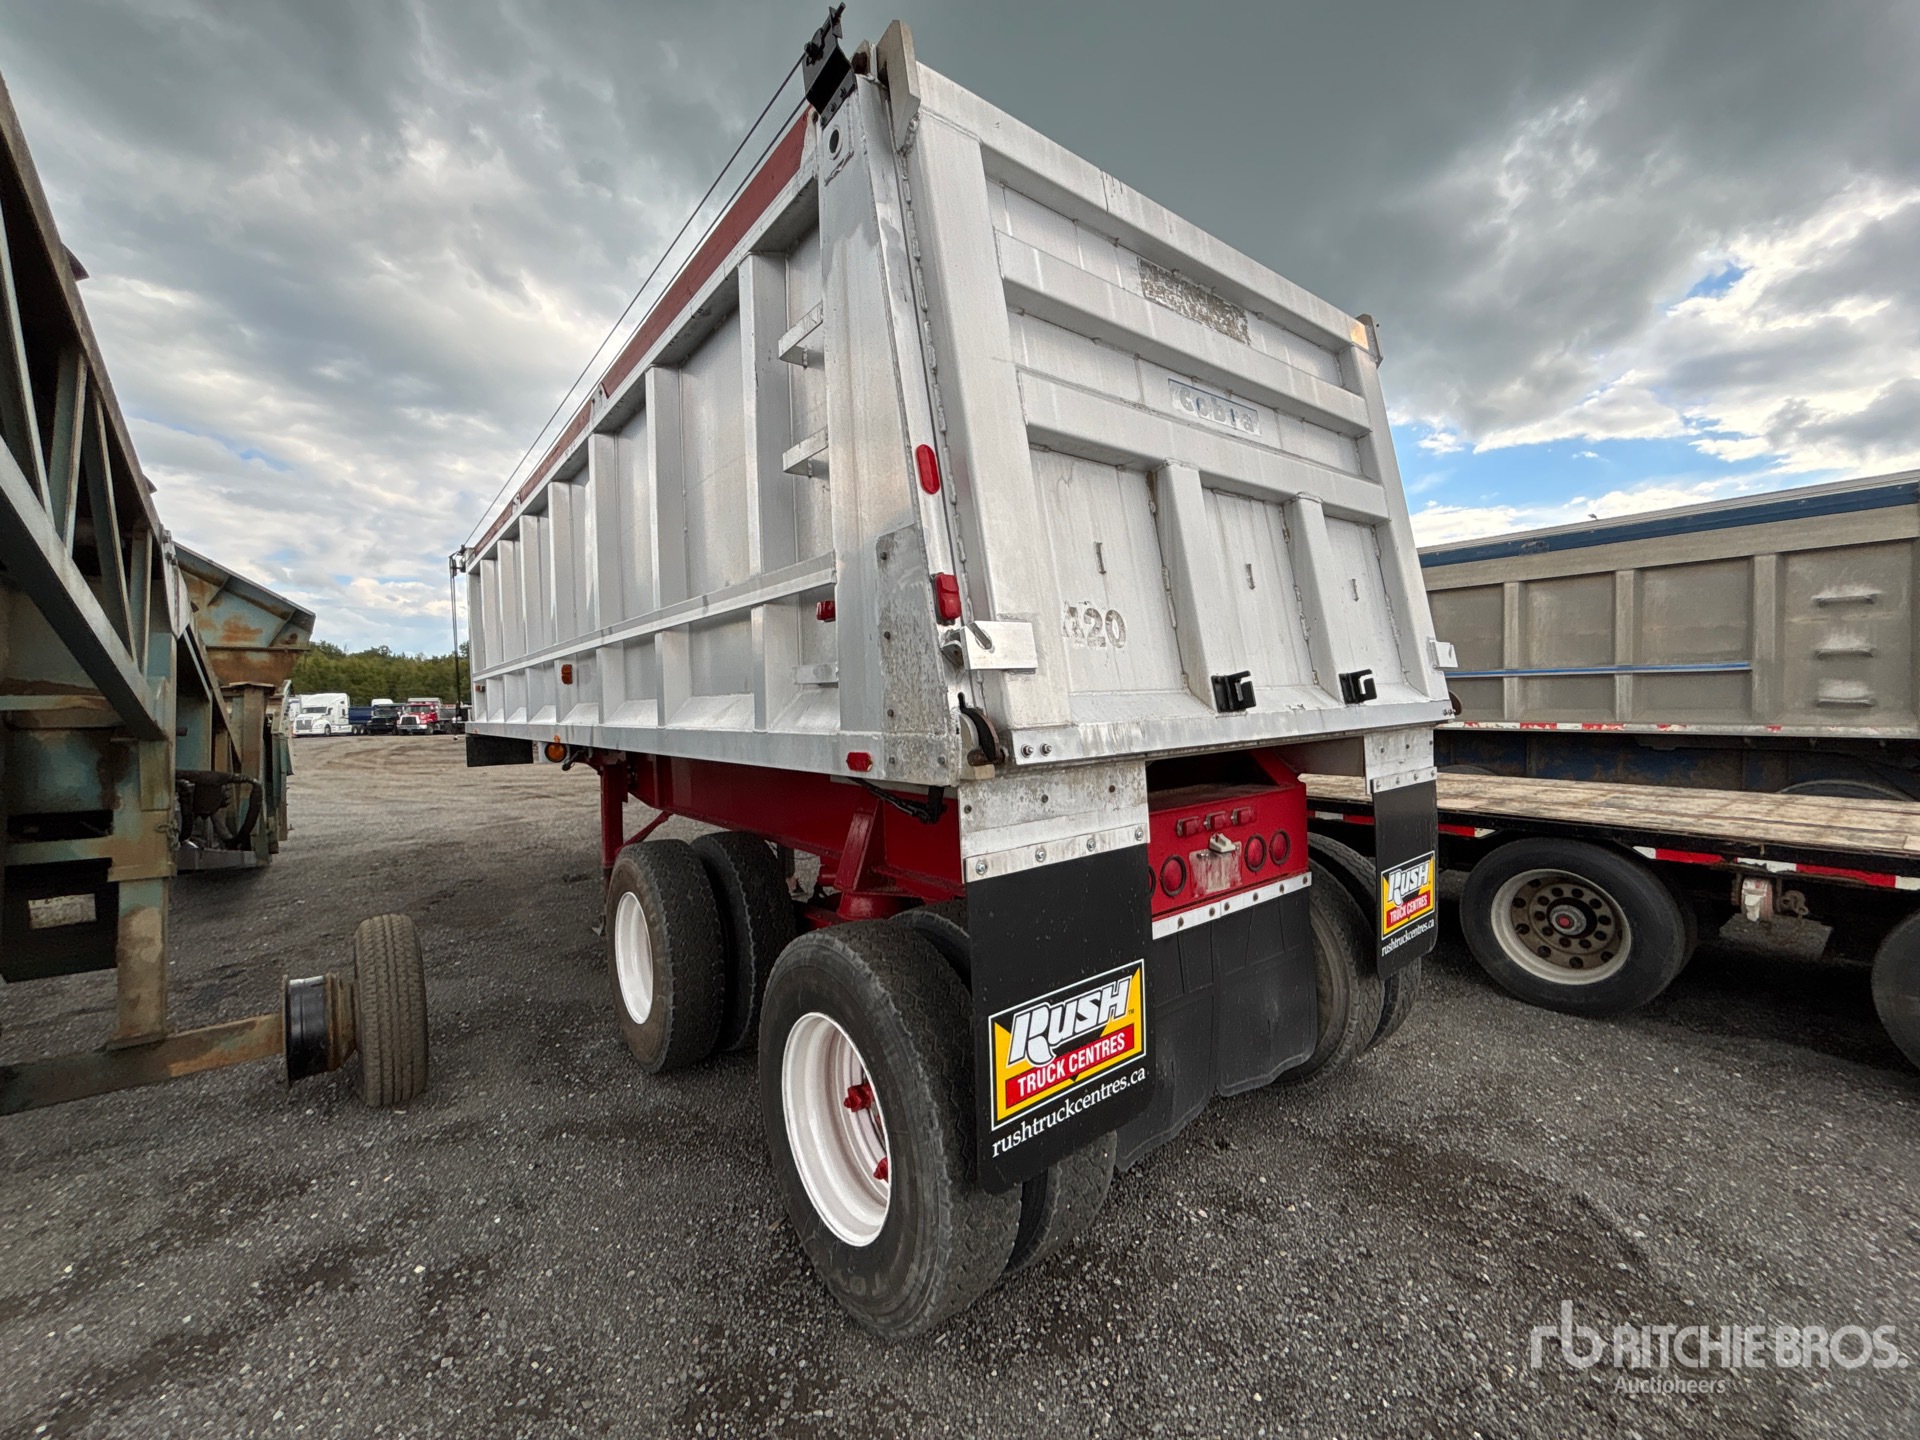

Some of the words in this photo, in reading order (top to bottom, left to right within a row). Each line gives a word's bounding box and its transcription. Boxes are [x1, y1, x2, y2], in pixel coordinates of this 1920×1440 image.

[1388, 861, 1430, 906] RUSH
[1381, 919, 1435, 957] rushtruckcentres.ca
[1006, 975, 1132, 1068] RUSH
[1018, 1061, 1066, 1097] TRUCK
[1069, 1032, 1126, 1072] CENTRES
[992, 1067, 1146, 1158] rushtruckcentres.ca
